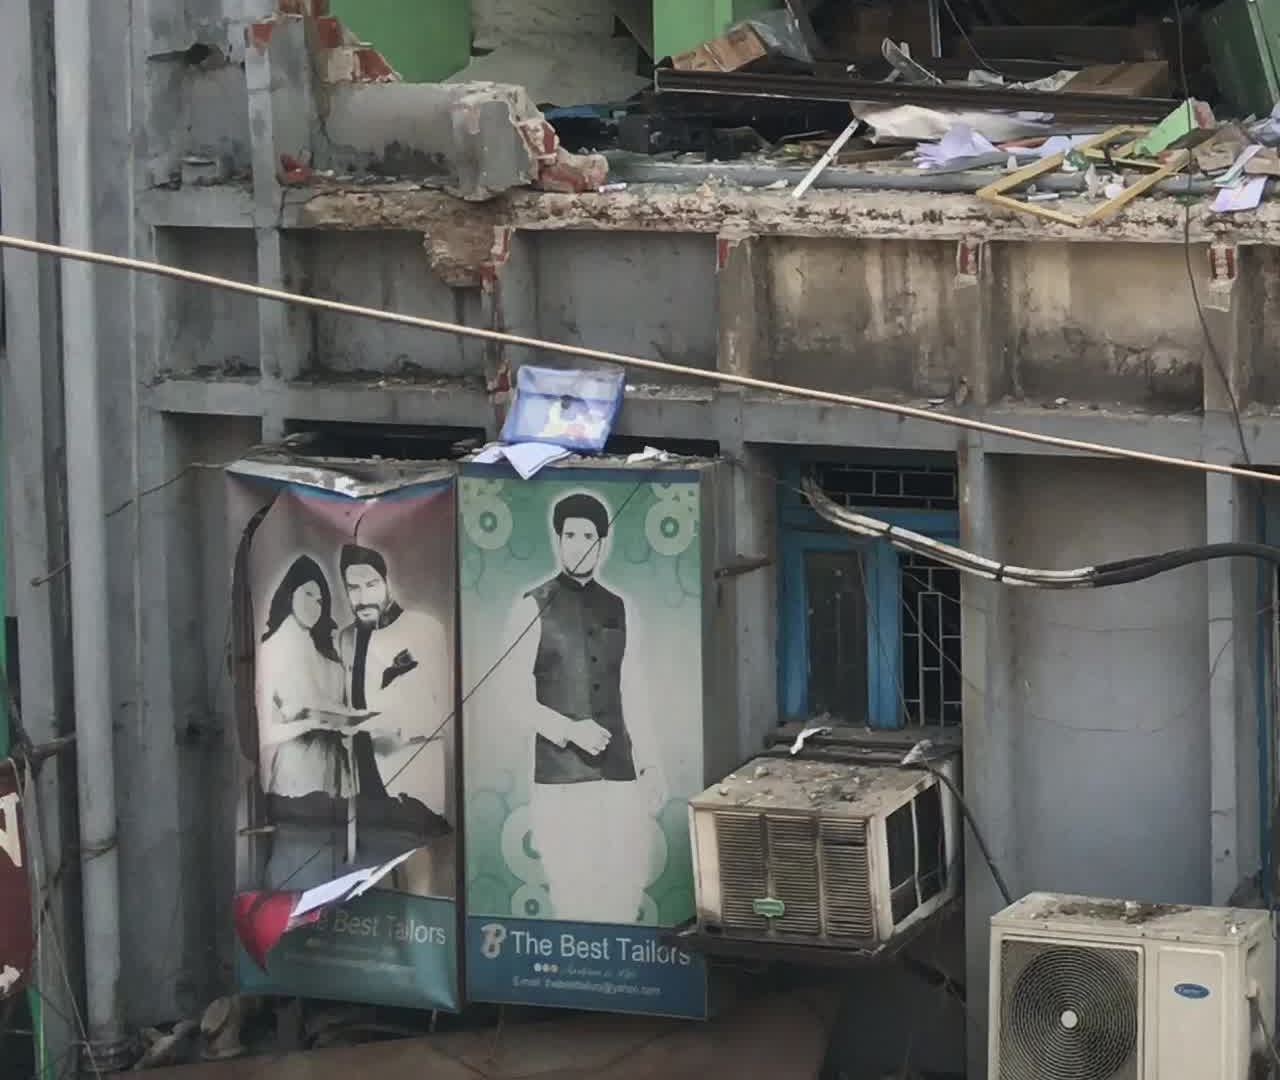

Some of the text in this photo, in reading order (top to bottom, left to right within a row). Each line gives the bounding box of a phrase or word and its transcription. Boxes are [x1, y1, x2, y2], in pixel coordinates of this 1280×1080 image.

[510, 929, 552, 957] The
[560, 934, 610, 960] Best
[616, 937, 691, 966] Tailors
